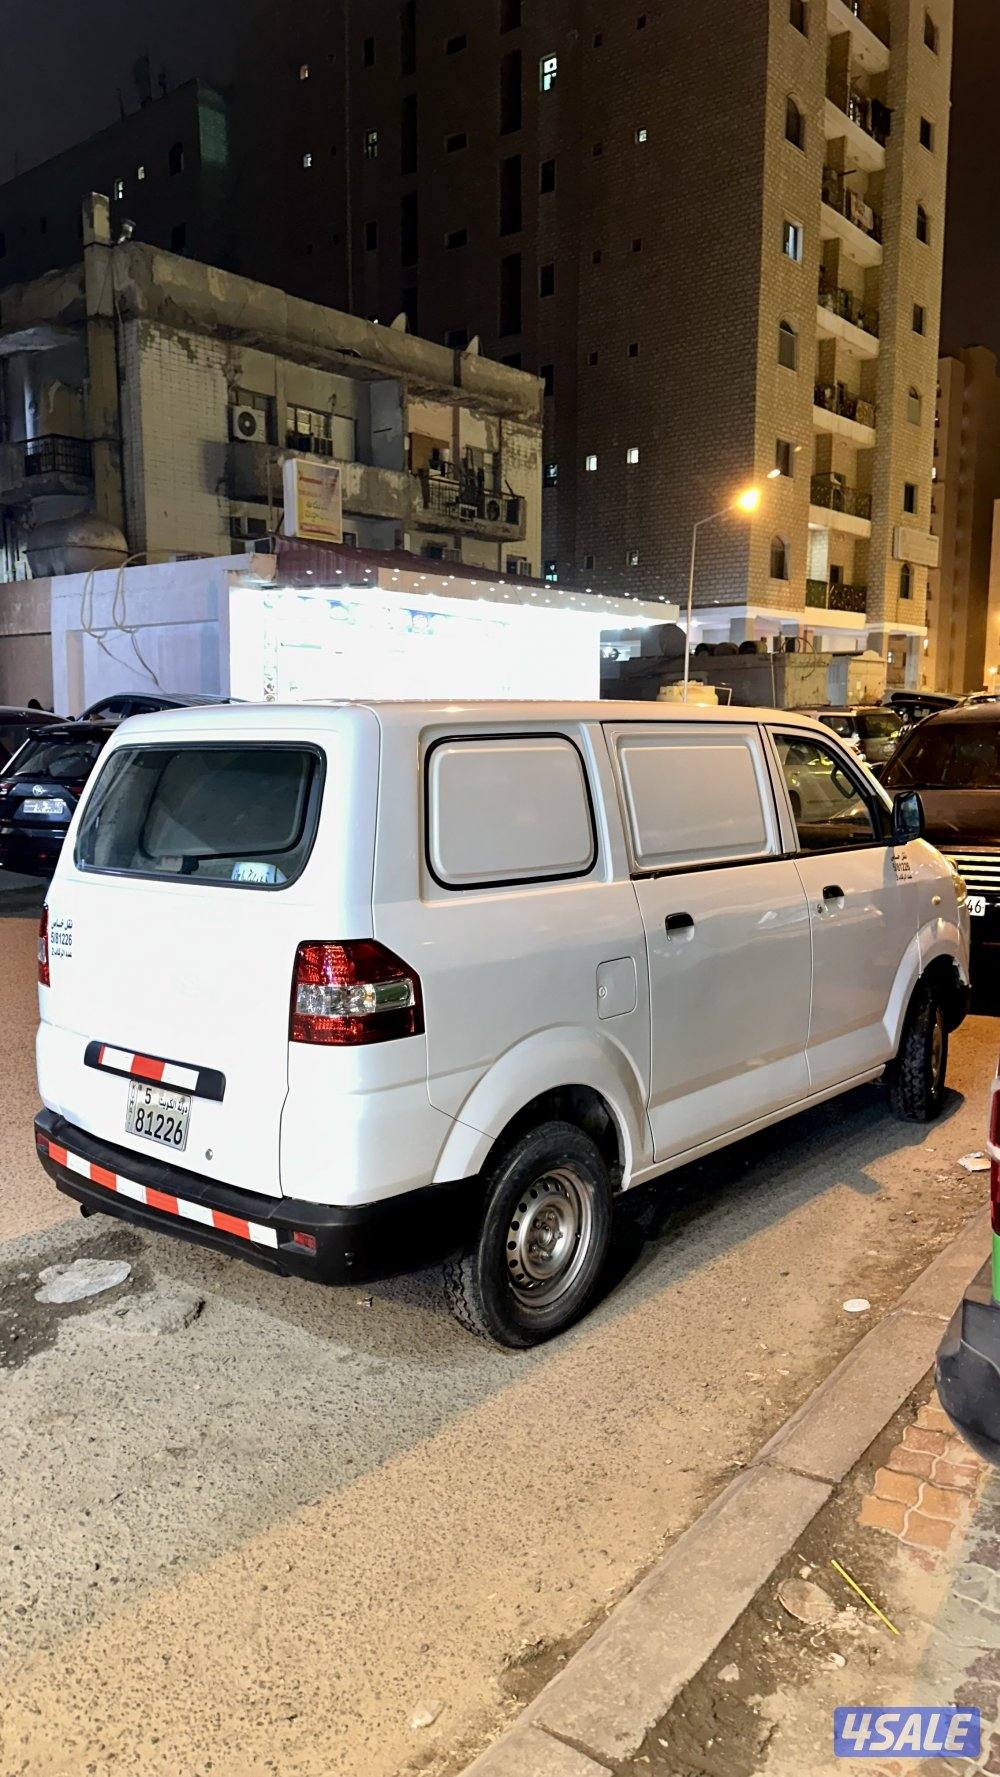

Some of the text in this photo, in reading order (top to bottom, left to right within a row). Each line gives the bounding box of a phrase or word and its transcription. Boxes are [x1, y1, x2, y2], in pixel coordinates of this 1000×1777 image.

[145, 1087, 152, 1105] 5
[159, 1097, 188, 1115] دولة الكويت
[135, 1107, 183, 1145] 81226
